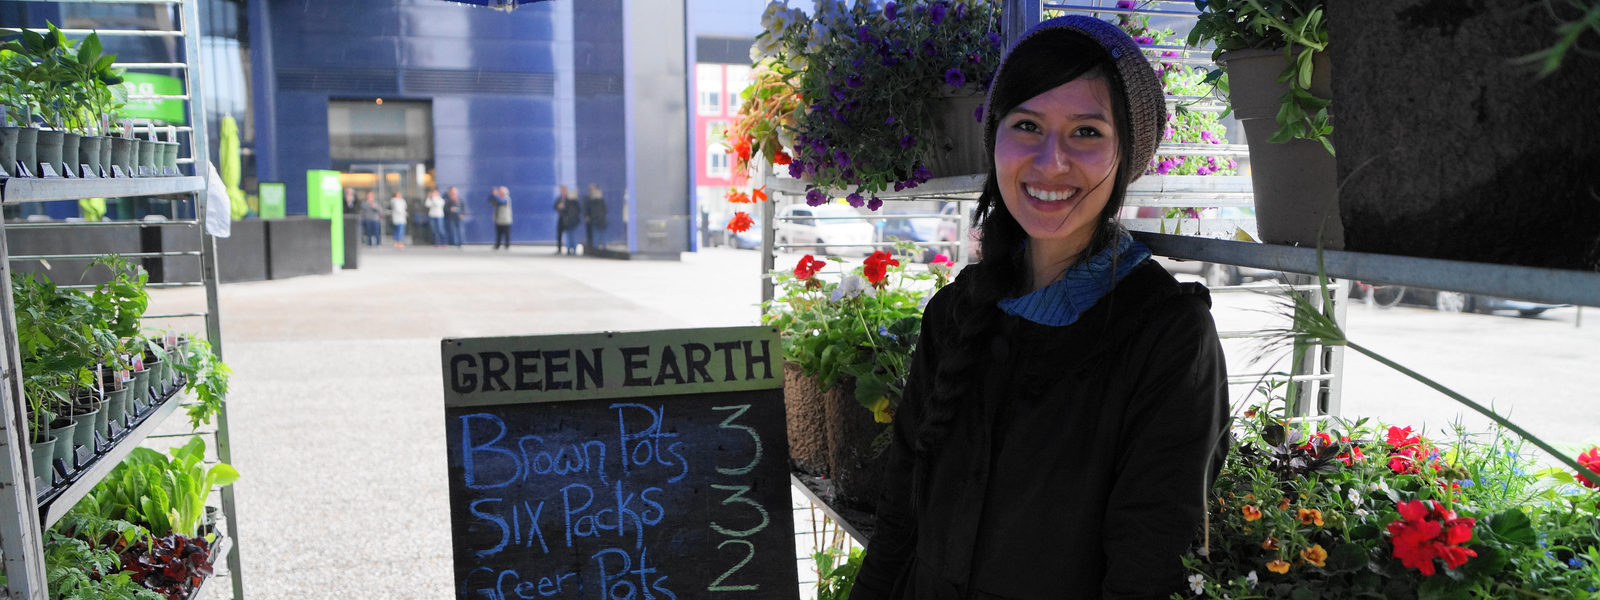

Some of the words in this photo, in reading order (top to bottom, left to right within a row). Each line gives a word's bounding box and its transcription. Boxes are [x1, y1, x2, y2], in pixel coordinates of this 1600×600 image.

[450, 347, 605, 393] GREEN
[621, 339, 775, 387] EARTH
[459, 412, 609, 490] Brown
[609, 402, 689, 483] Pots
[711, 404, 763, 475] 3
[560, 480, 665, 549] Packs
[710, 484, 770, 537] 3
[592, 546, 678, 600] Pots
[707, 539, 760, 592] 2
